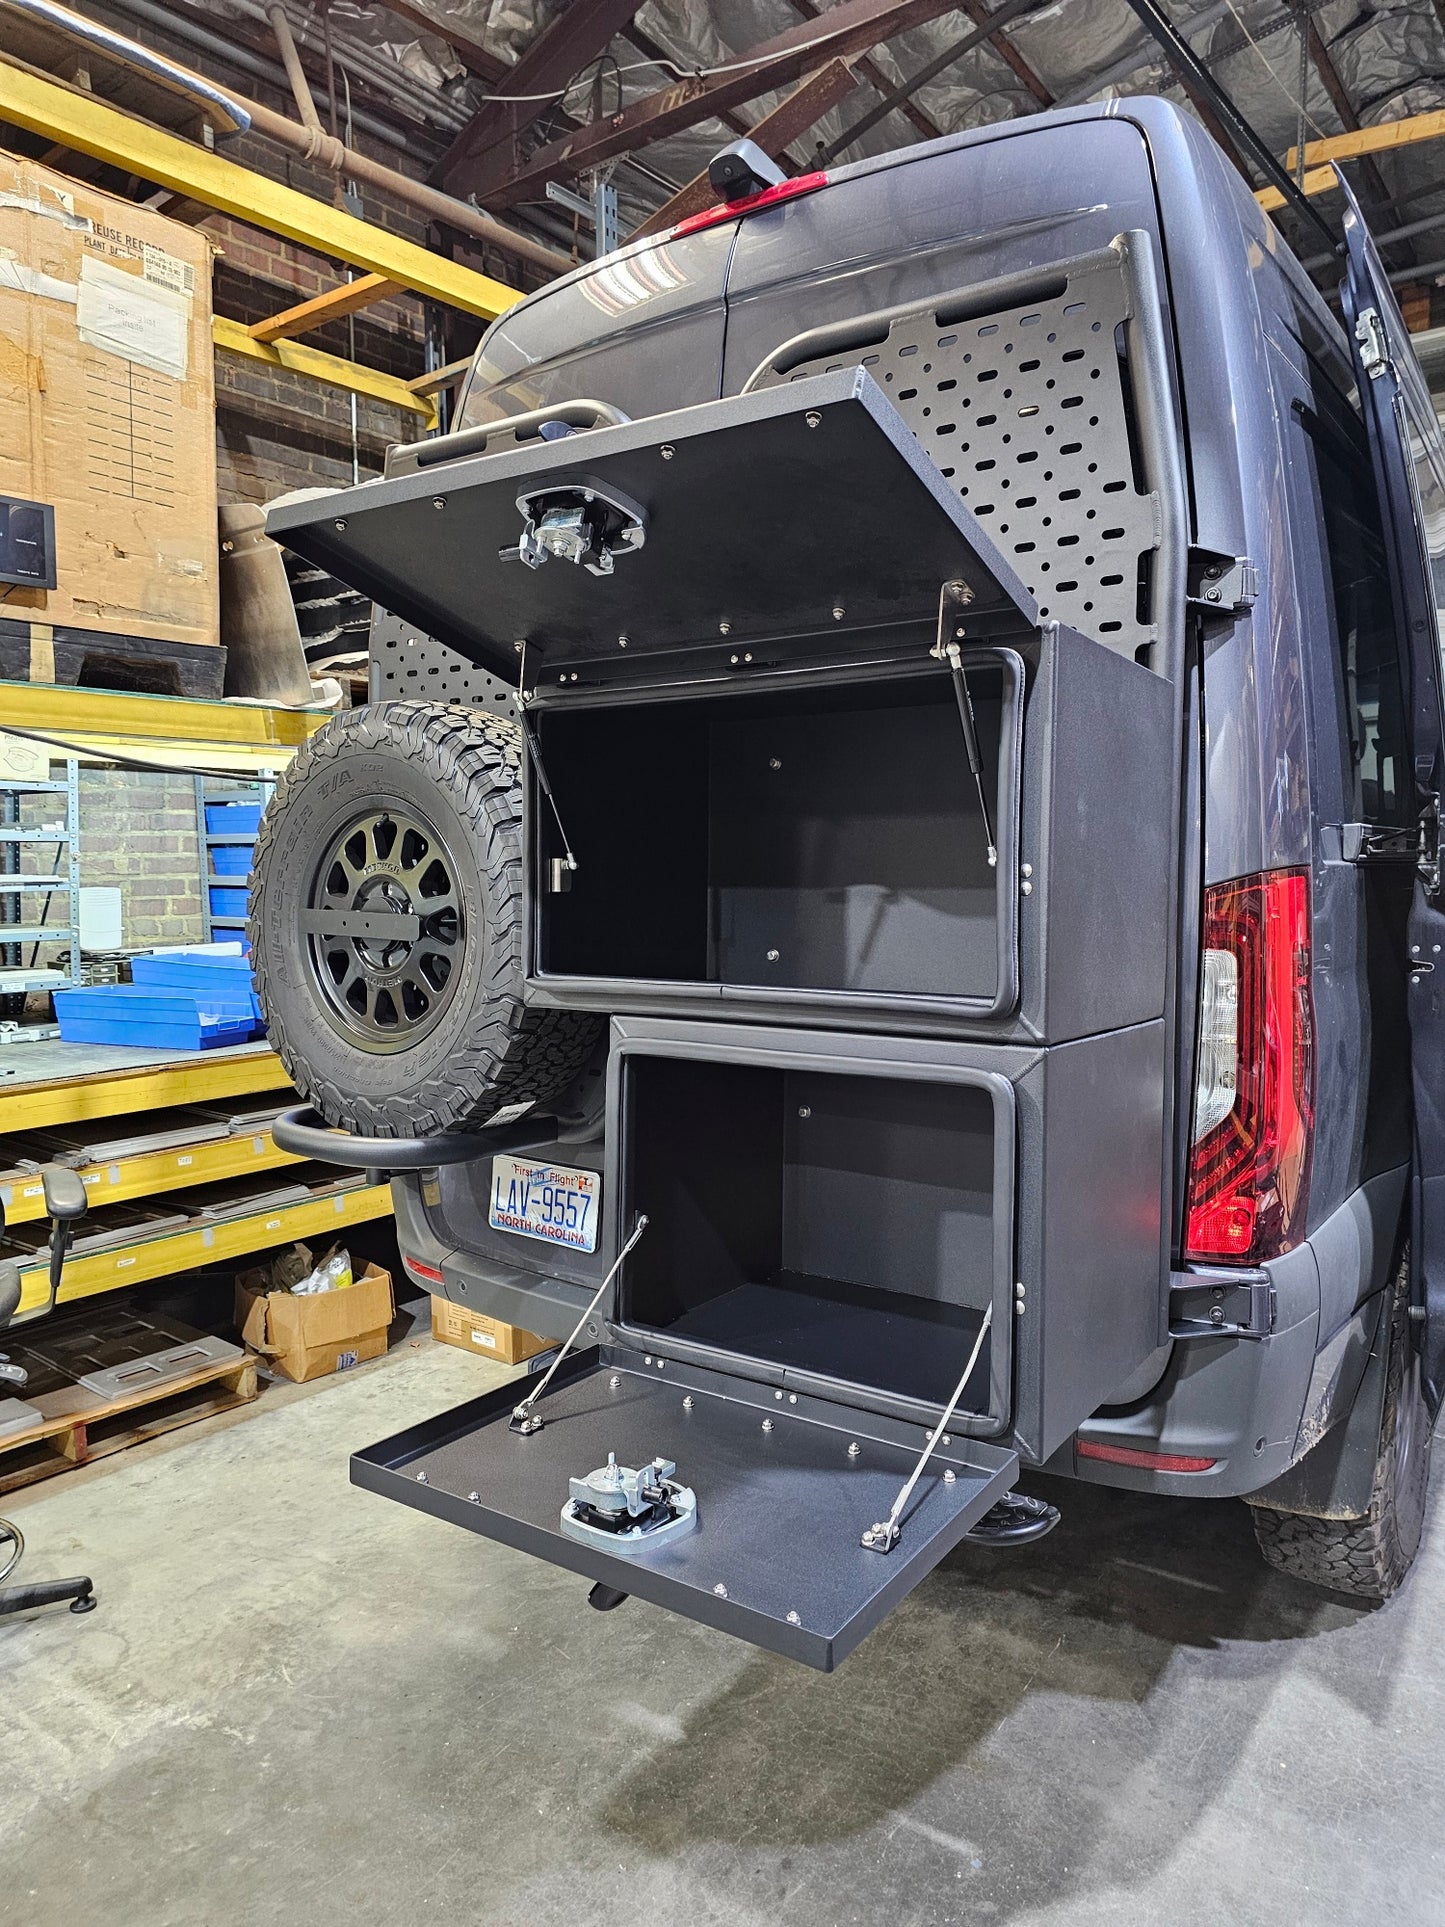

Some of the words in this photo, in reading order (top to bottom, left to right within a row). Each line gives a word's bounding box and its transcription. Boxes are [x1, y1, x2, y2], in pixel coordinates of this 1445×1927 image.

[84, 235, 106, 250] PLANT
[125, 235, 165, 254] REC
[317, 769, 354, 800] T/A
[514, 1165, 533, 1177] First
[537, 1171, 545, 1180] in
[549, 1173, 575, 1187] Flight
[495, 1176, 592, 1232] LAV-9557
[497, 1213, 532, 1232] NORTH
[535, 1223, 586, 1246] CAROLINA
